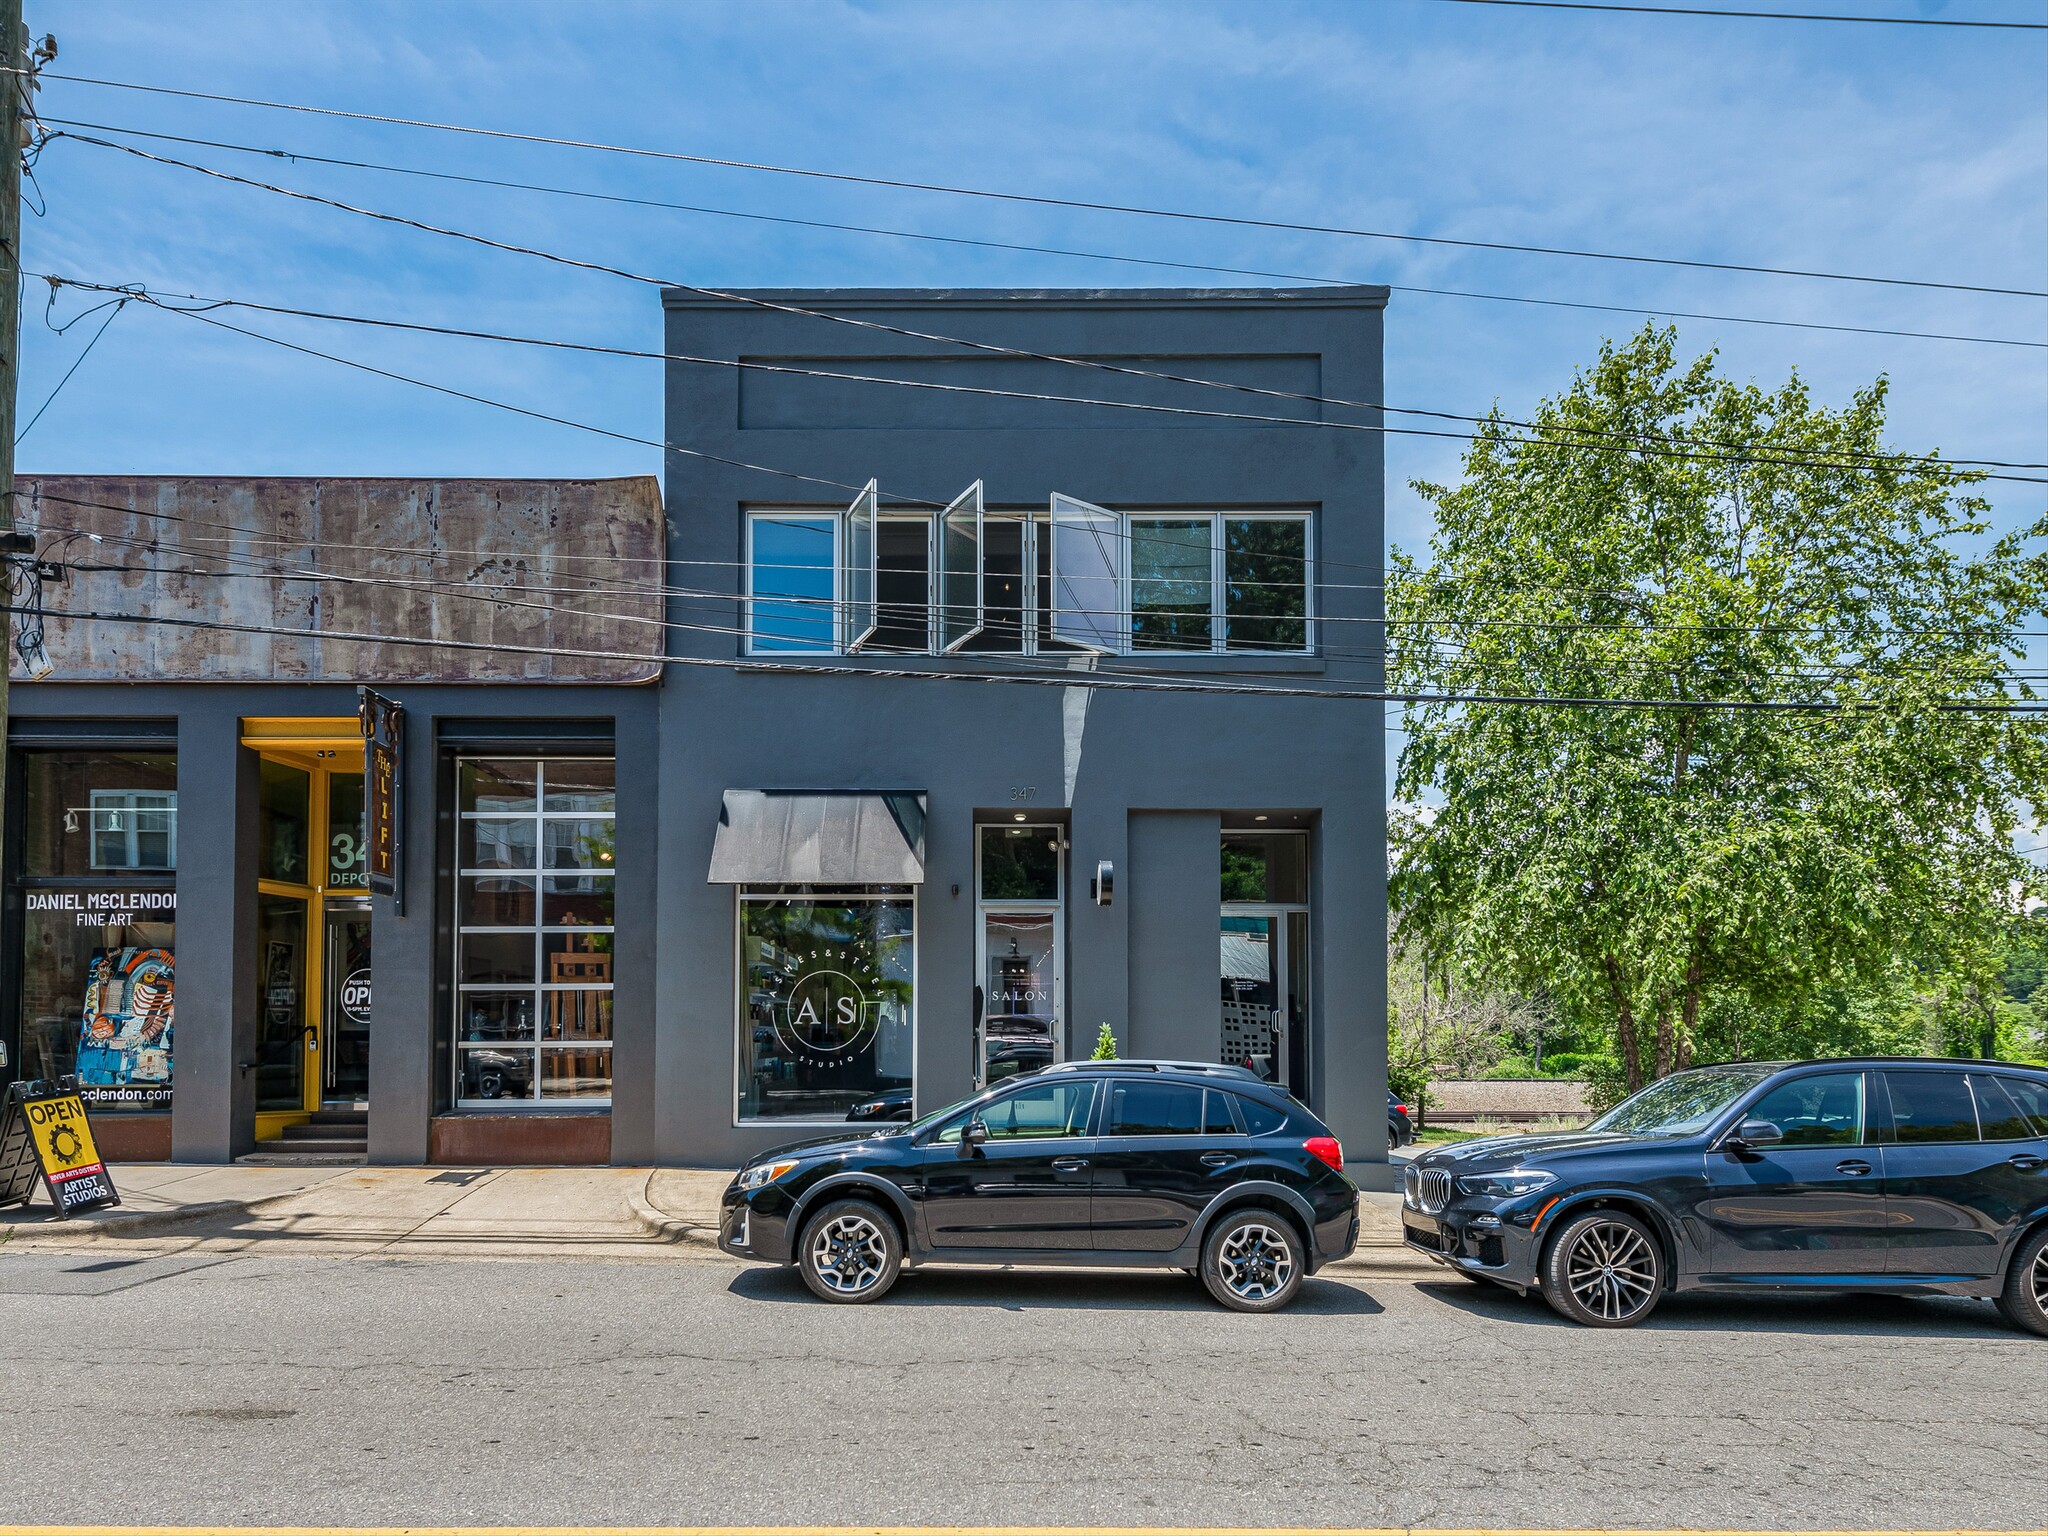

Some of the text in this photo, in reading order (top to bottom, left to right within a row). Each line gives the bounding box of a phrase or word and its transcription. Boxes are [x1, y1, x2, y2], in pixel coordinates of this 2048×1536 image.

[376, 749, 391, 777] THE
[1009, 786, 1036, 801] 347
[379, 777, 388, 869] LIFT
[26, 893, 177, 910] DANIEL McCLENDO
[76, 913, 134, 927] FINE ART
[769, 950, 818, 998] ASHES
[992, 990, 1047, 1001] SALON
[799, 1056, 854, 1068] STUDIO
[29, 1098, 84, 1126] OPEN
[49, 1164, 101, 1182] RIVER ARTS DISTRICT
[63, 1175, 98, 1194] ARTIST
[62, 1185, 108, 1206] STUDIOS
